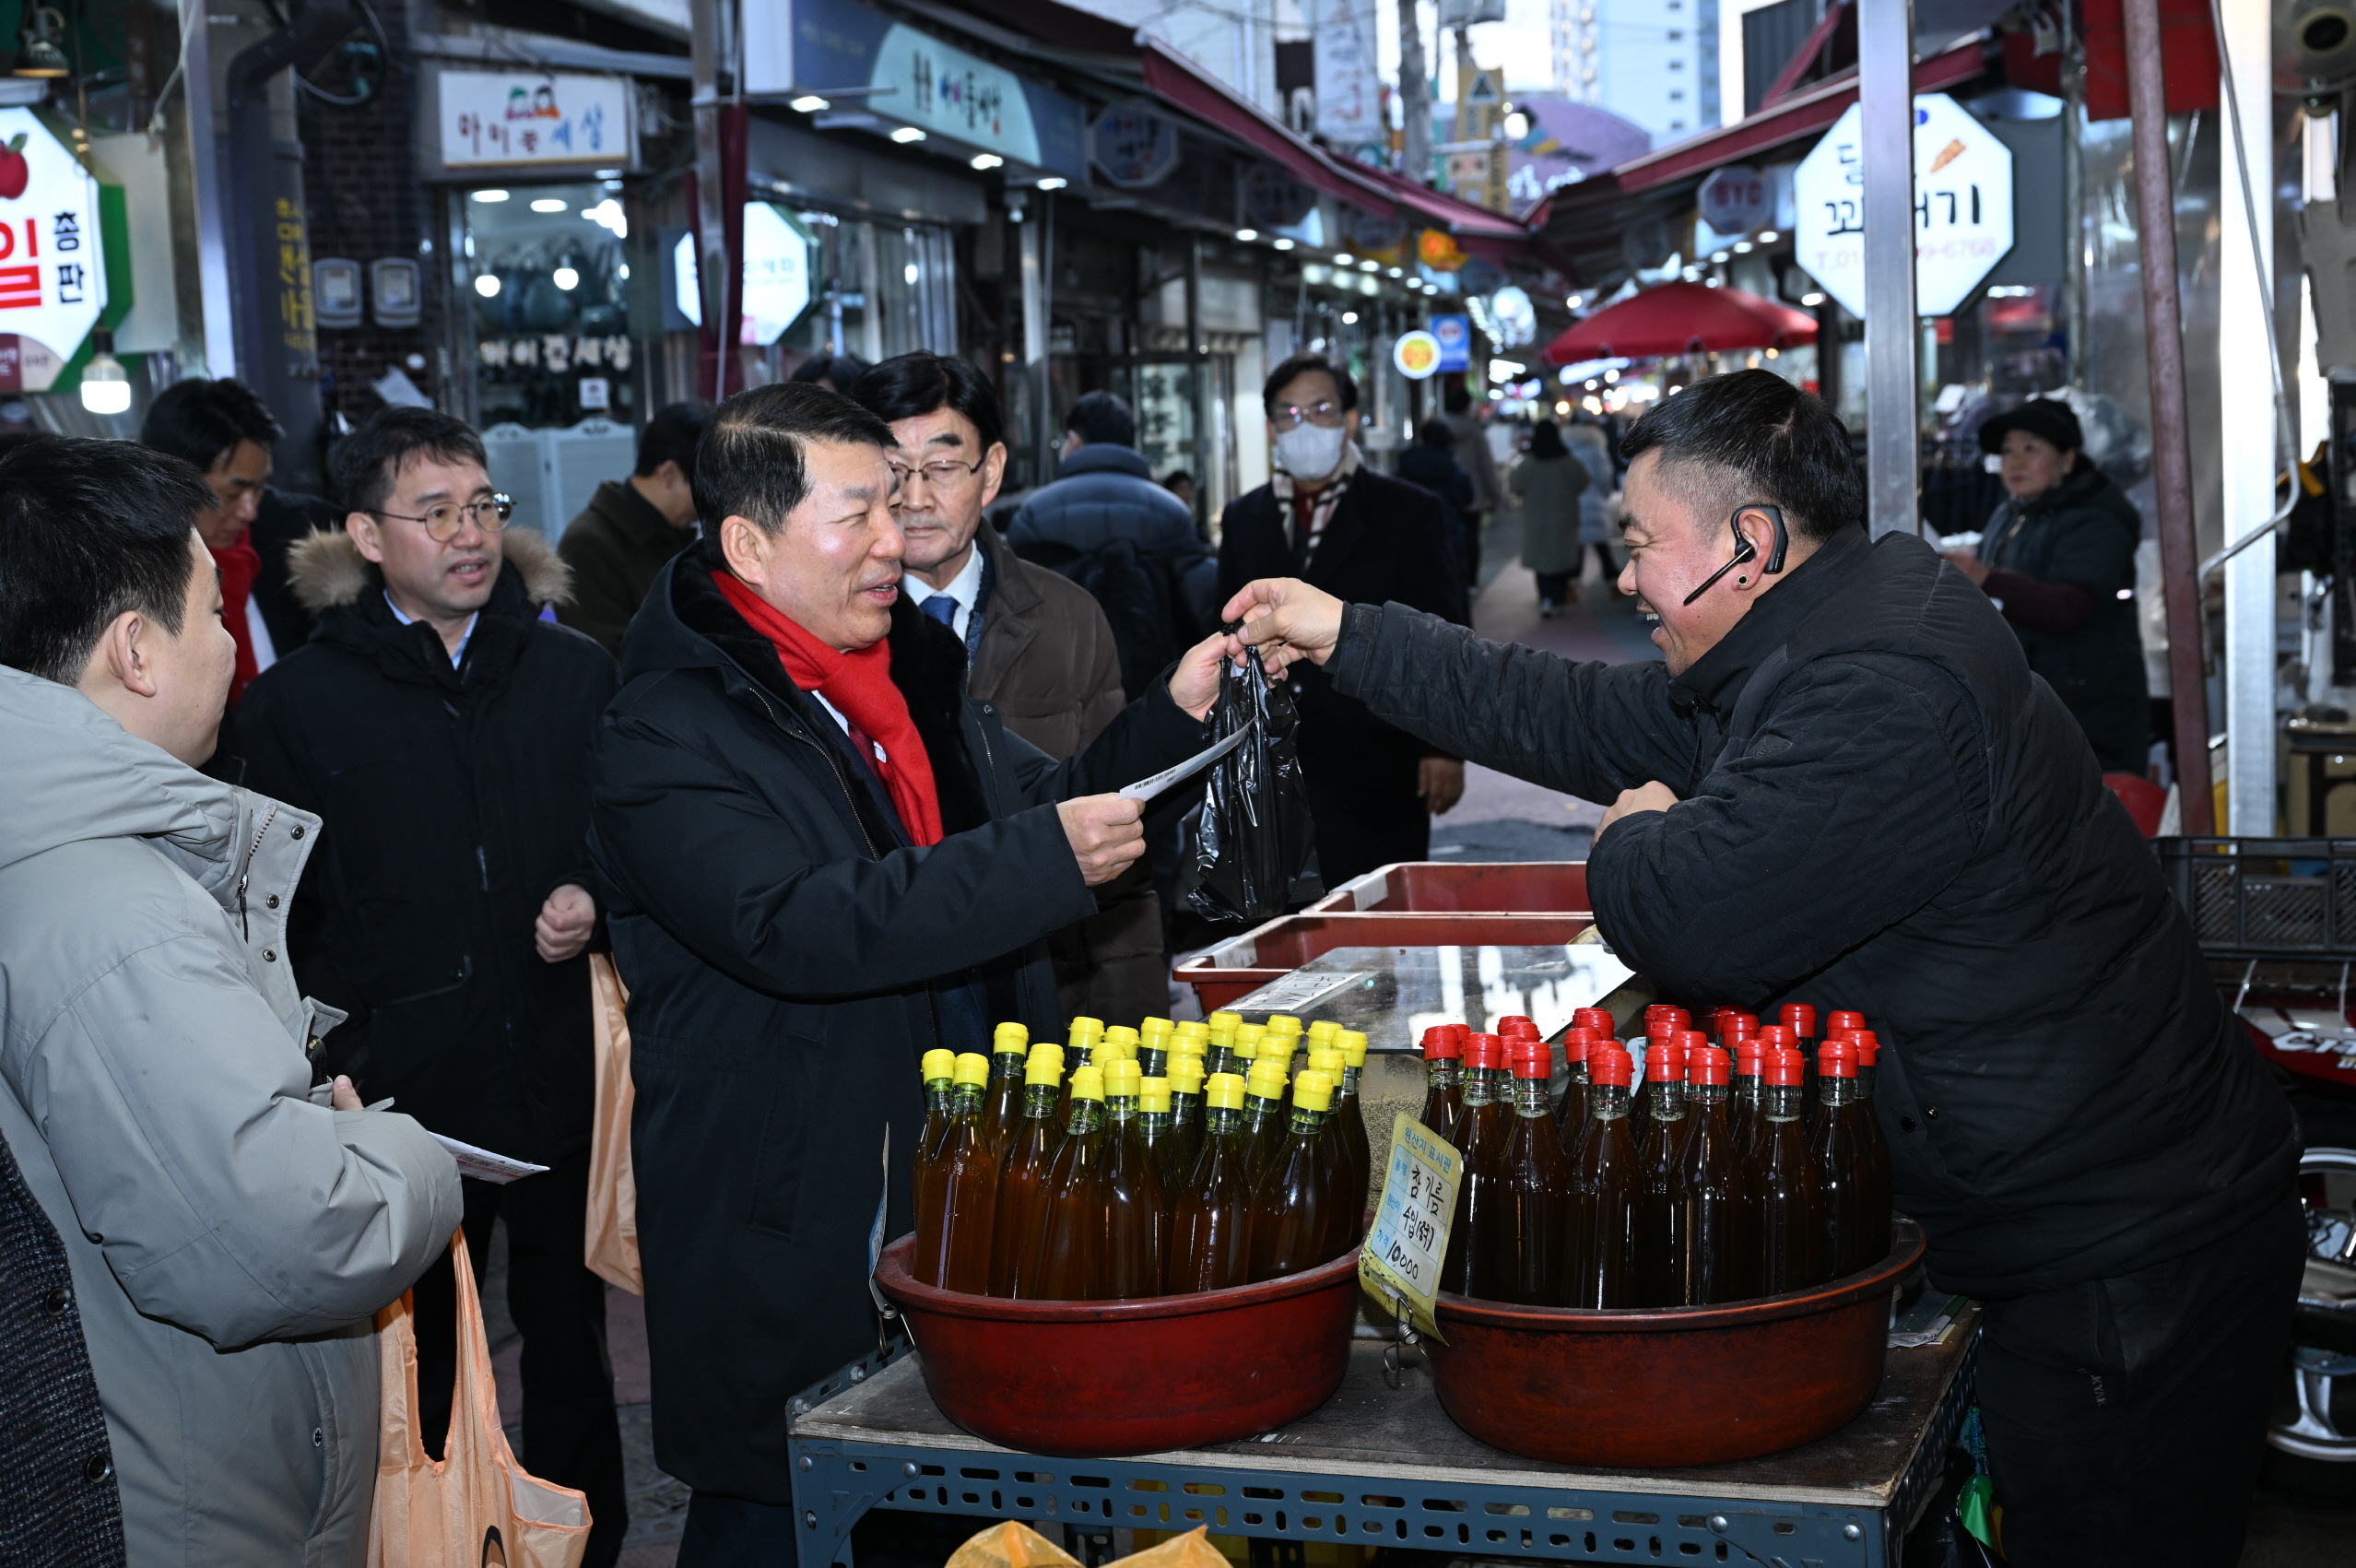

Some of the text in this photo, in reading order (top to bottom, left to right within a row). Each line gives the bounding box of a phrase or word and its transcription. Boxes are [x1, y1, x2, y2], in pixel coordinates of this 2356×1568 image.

[53, 211, 85, 304] 총판
[1404, 1126, 1453, 1175] 원산지 표시판
[1395, 1158, 1408, 1177] 품명
[1386, 1193, 1402, 1214] 원산지
[1376, 1229, 1390, 1249] 가격
